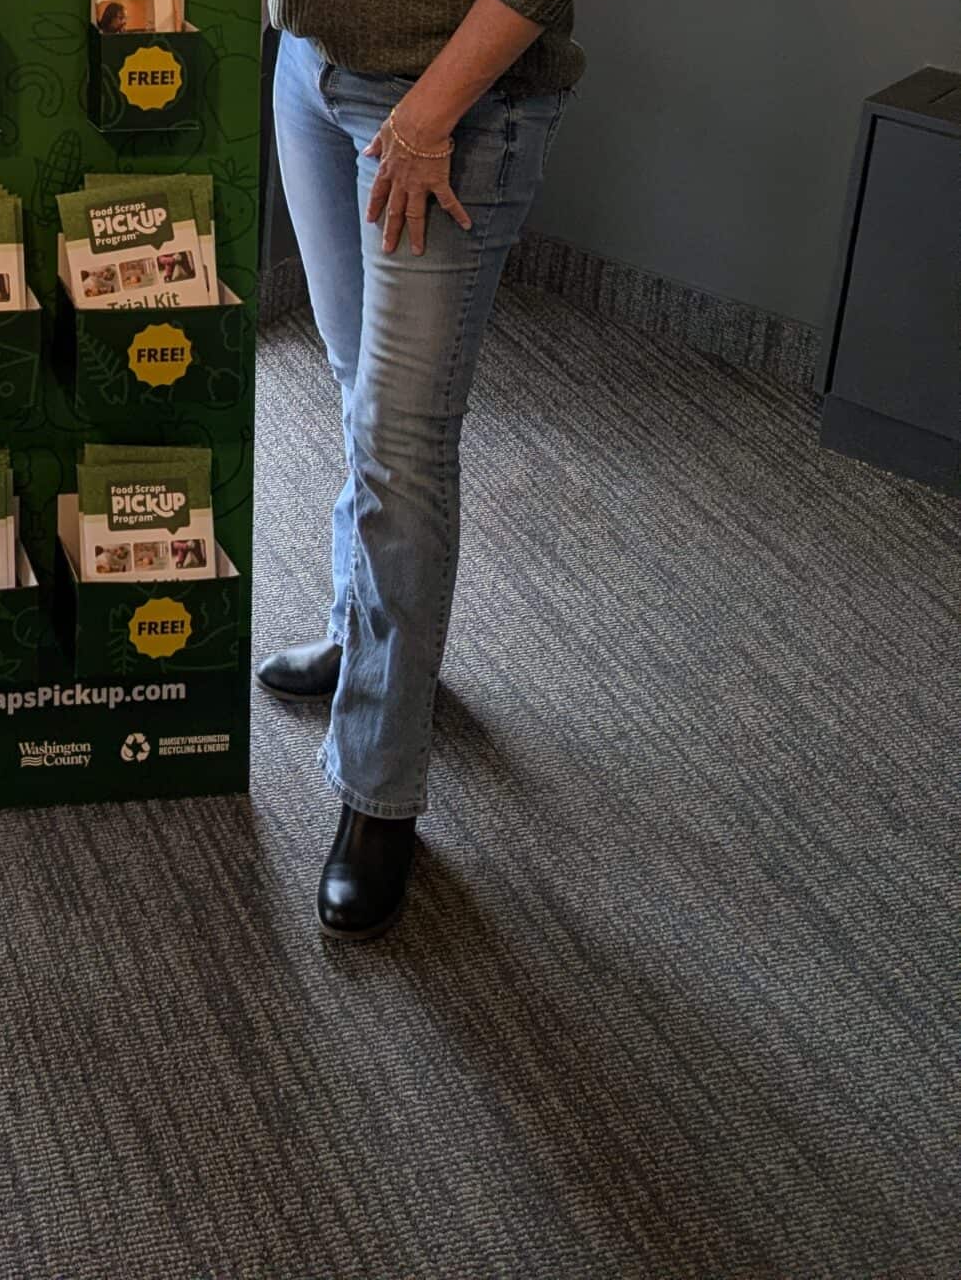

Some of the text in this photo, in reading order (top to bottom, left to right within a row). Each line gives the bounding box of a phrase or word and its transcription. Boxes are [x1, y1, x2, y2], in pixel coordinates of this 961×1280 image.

[128, 70, 174, 86] FREE!
[90, 202, 146, 218] Food Scraps
[154, 291, 180, 308] Kit
[137, 348, 184, 363] FREE!
[111, 485, 166, 495] Food Scraps
[138, 620, 184, 636] FREE!
[18, 740, 91, 756] Washington
[42, 754, 92, 767] County
